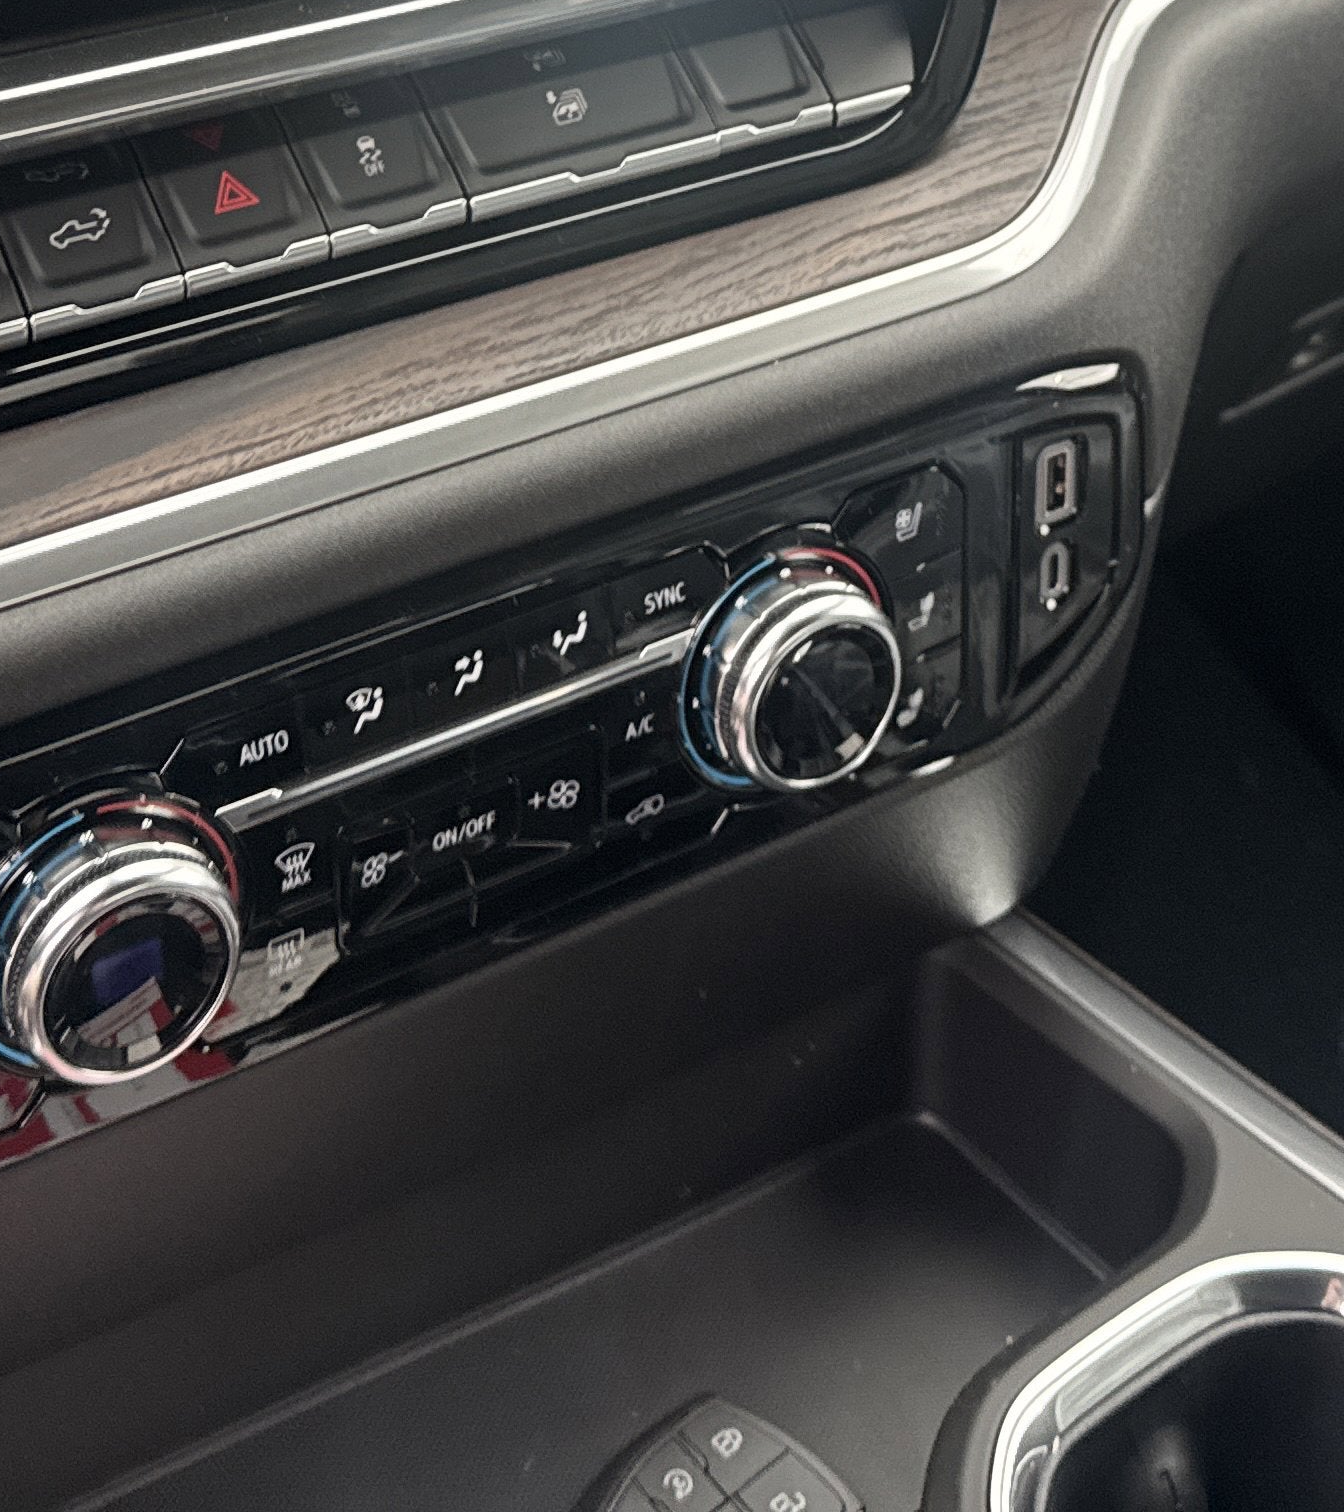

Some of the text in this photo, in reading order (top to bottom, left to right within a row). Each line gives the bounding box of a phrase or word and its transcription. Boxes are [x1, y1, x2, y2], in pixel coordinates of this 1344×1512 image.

[643, 581, 687, 615] SYNC
[624, 712, 655, 742] A/C
[239, 729, 289, 767] AUTO
[432, 810, 497, 852] ON/OFF
